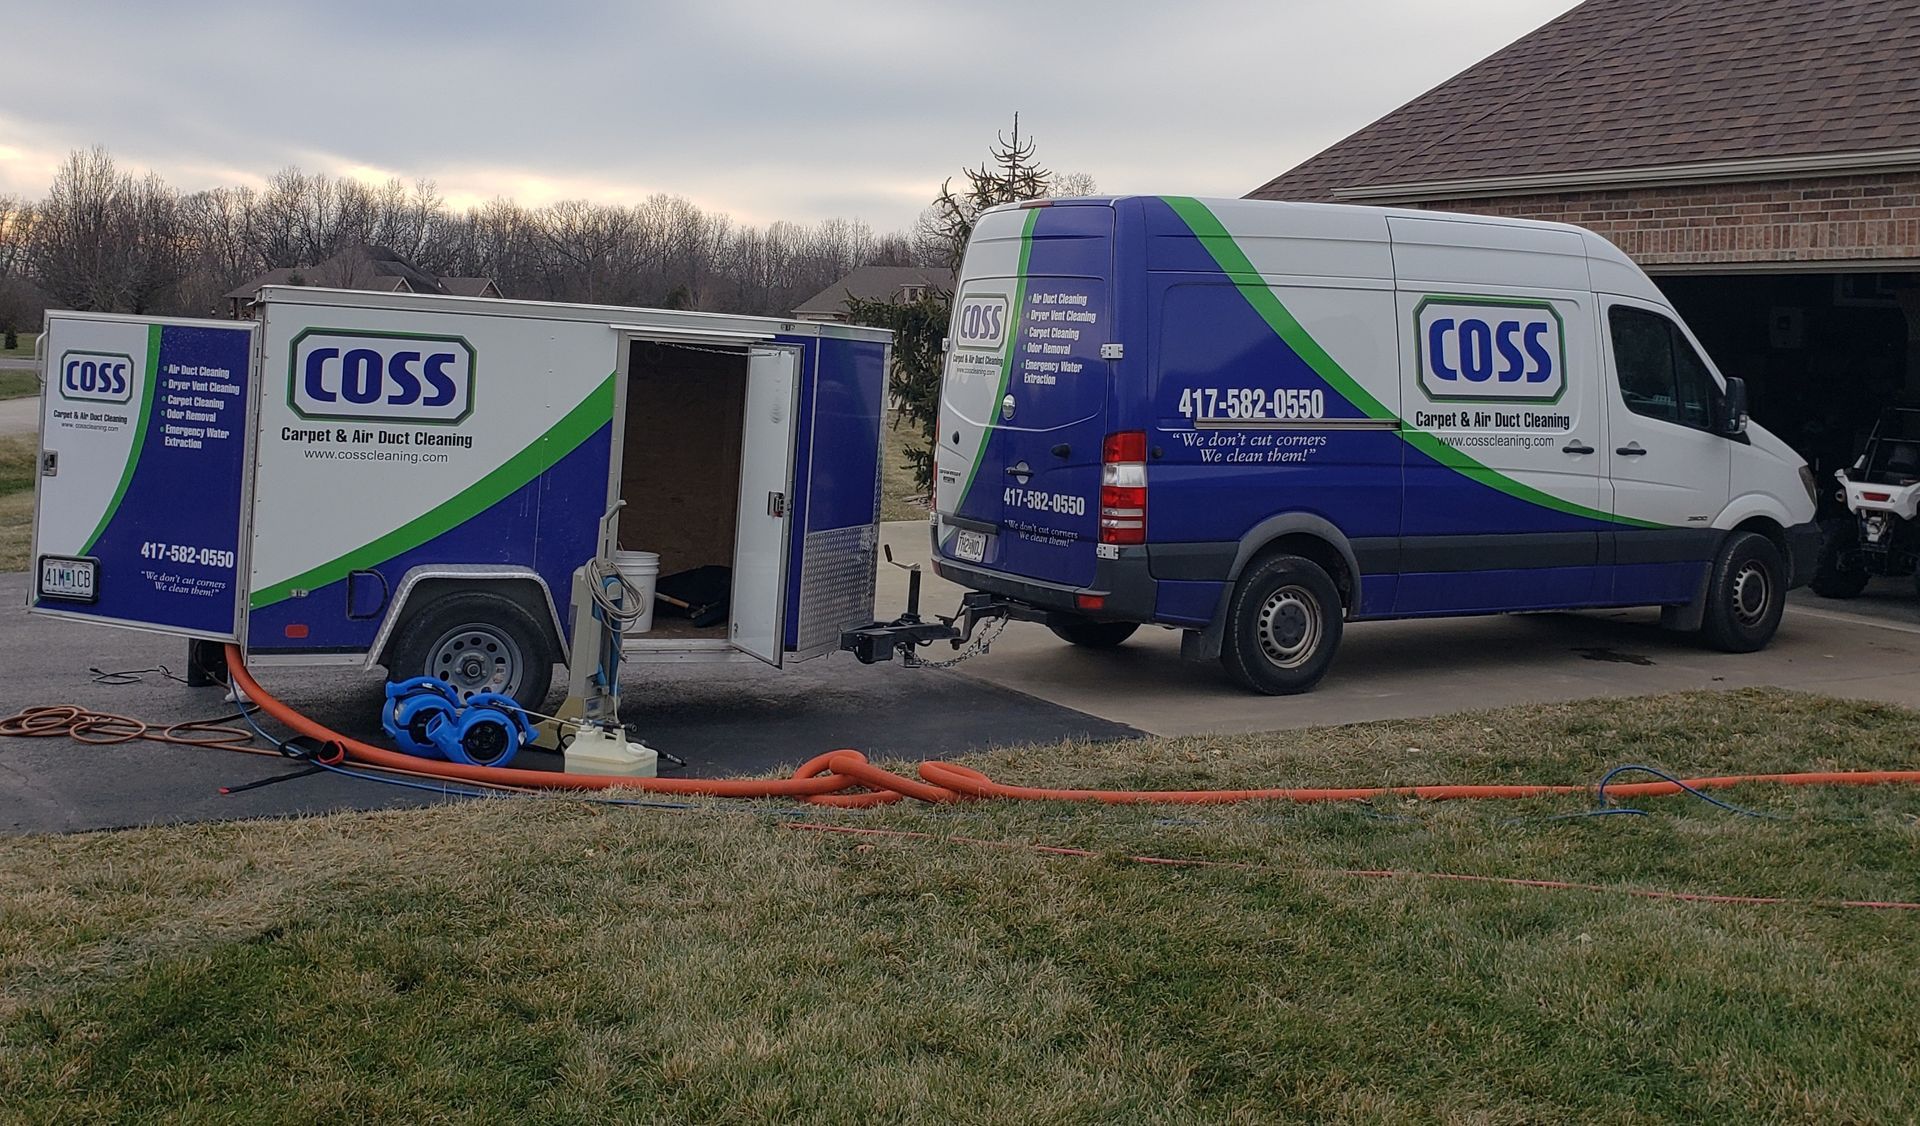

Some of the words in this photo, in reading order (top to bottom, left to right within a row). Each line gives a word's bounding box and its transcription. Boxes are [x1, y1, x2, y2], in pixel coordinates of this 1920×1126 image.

[1032, 293, 1042, 304] Air
[1042, 293, 1057, 304] Duct
[1058, 294, 1088, 306] Cleaning
[960, 304, 1002, 340] COSS
[1030, 310, 1050, 322] Dryer
[1051, 310, 1065, 321] Vent
[1066, 310, 1096, 324] Cleaning
[1029, 327, 1050, 339] Carpet
[1051, 327, 1080, 340] Cleaning
[1027, 342, 1042, 353] Odor
[1043, 343, 1071, 355] Removal
[1428, 318, 1552, 382] COSS
[168, 364, 180, 374] Air
[181, 365, 198, 375] Duct
[199, 366, 230, 379] Cleaning
[1025, 359, 1060, 373] Emergency
[1060, 361, 1083, 373] Water
[66, 360, 126, 394] COSS
[305, 348, 456, 406] COSS
[1024, 372, 1056, 385] Extraction
[168, 379, 190, 391] Dryer
[192, 381, 208, 391] Vent
[209, 382, 240, 395] Cleaning
[167, 395, 193, 407] Carpet
[194, 396, 225, 410] Cleaning
[1178, 388, 1324, 418] 417-582-0550
[54, 410, 72, 419] Carpet
[80, 412, 88, 420] Air
[90, 413, 102, 421] Duct
[104, 414, 127, 424] Cleaning
[166, 409, 185, 419] Odor
[186, 410, 216, 422] Removal
[1416, 411, 1457, 429] Carpet
[1461, 412, 1470, 427] &
[1474, 412, 1491, 428] Air
[1495, 412, 1520, 428] Duct
[1524, 413, 1570, 430] Cleaning
[165, 424, 205, 438] Emergency
[206, 427, 230, 439] Water
[281, 427, 331, 443] Carpet
[336, 429, 347, 442] &
[352, 430, 374, 443] Air
[378, 430, 410, 445] Duct
[414, 432, 473, 448] Cleaning
[1208, 432, 1246, 446] don't
[1250, 434, 1272, 446] cut
[1276, 435, 1326, 446] corners
[164, 436, 202, 449] Extraction
[1437, 434, 1554, 448] www.cosscleaning.com
[304, 450, 448, 464] www.cosscleaning.com
[1200, 449, 1222, 462] We
[1226, 449, 1263, 462] clean
[1003, 488, 1085, 516] 417-582-0550
[1020, 521, 1037, 532] don't
[1038, 526, 1049, 534] cut
[1051, 528, 1078, 539] corners
[1020, 531, 1030, 540] We
[1030, 534, 1048, 544] clean
[141, 542, 234, 568] 417-582-0550
[45, 568, 64, 586] 41M
[72, 570, 90, 588] 1CB
[160, 573, 180, 583] don't
[182, 577, 195, 585] cut
[196, 579, 226, 589] corners
[154, 581, 167, 591] We
[168, 583, 189, 594] clean
